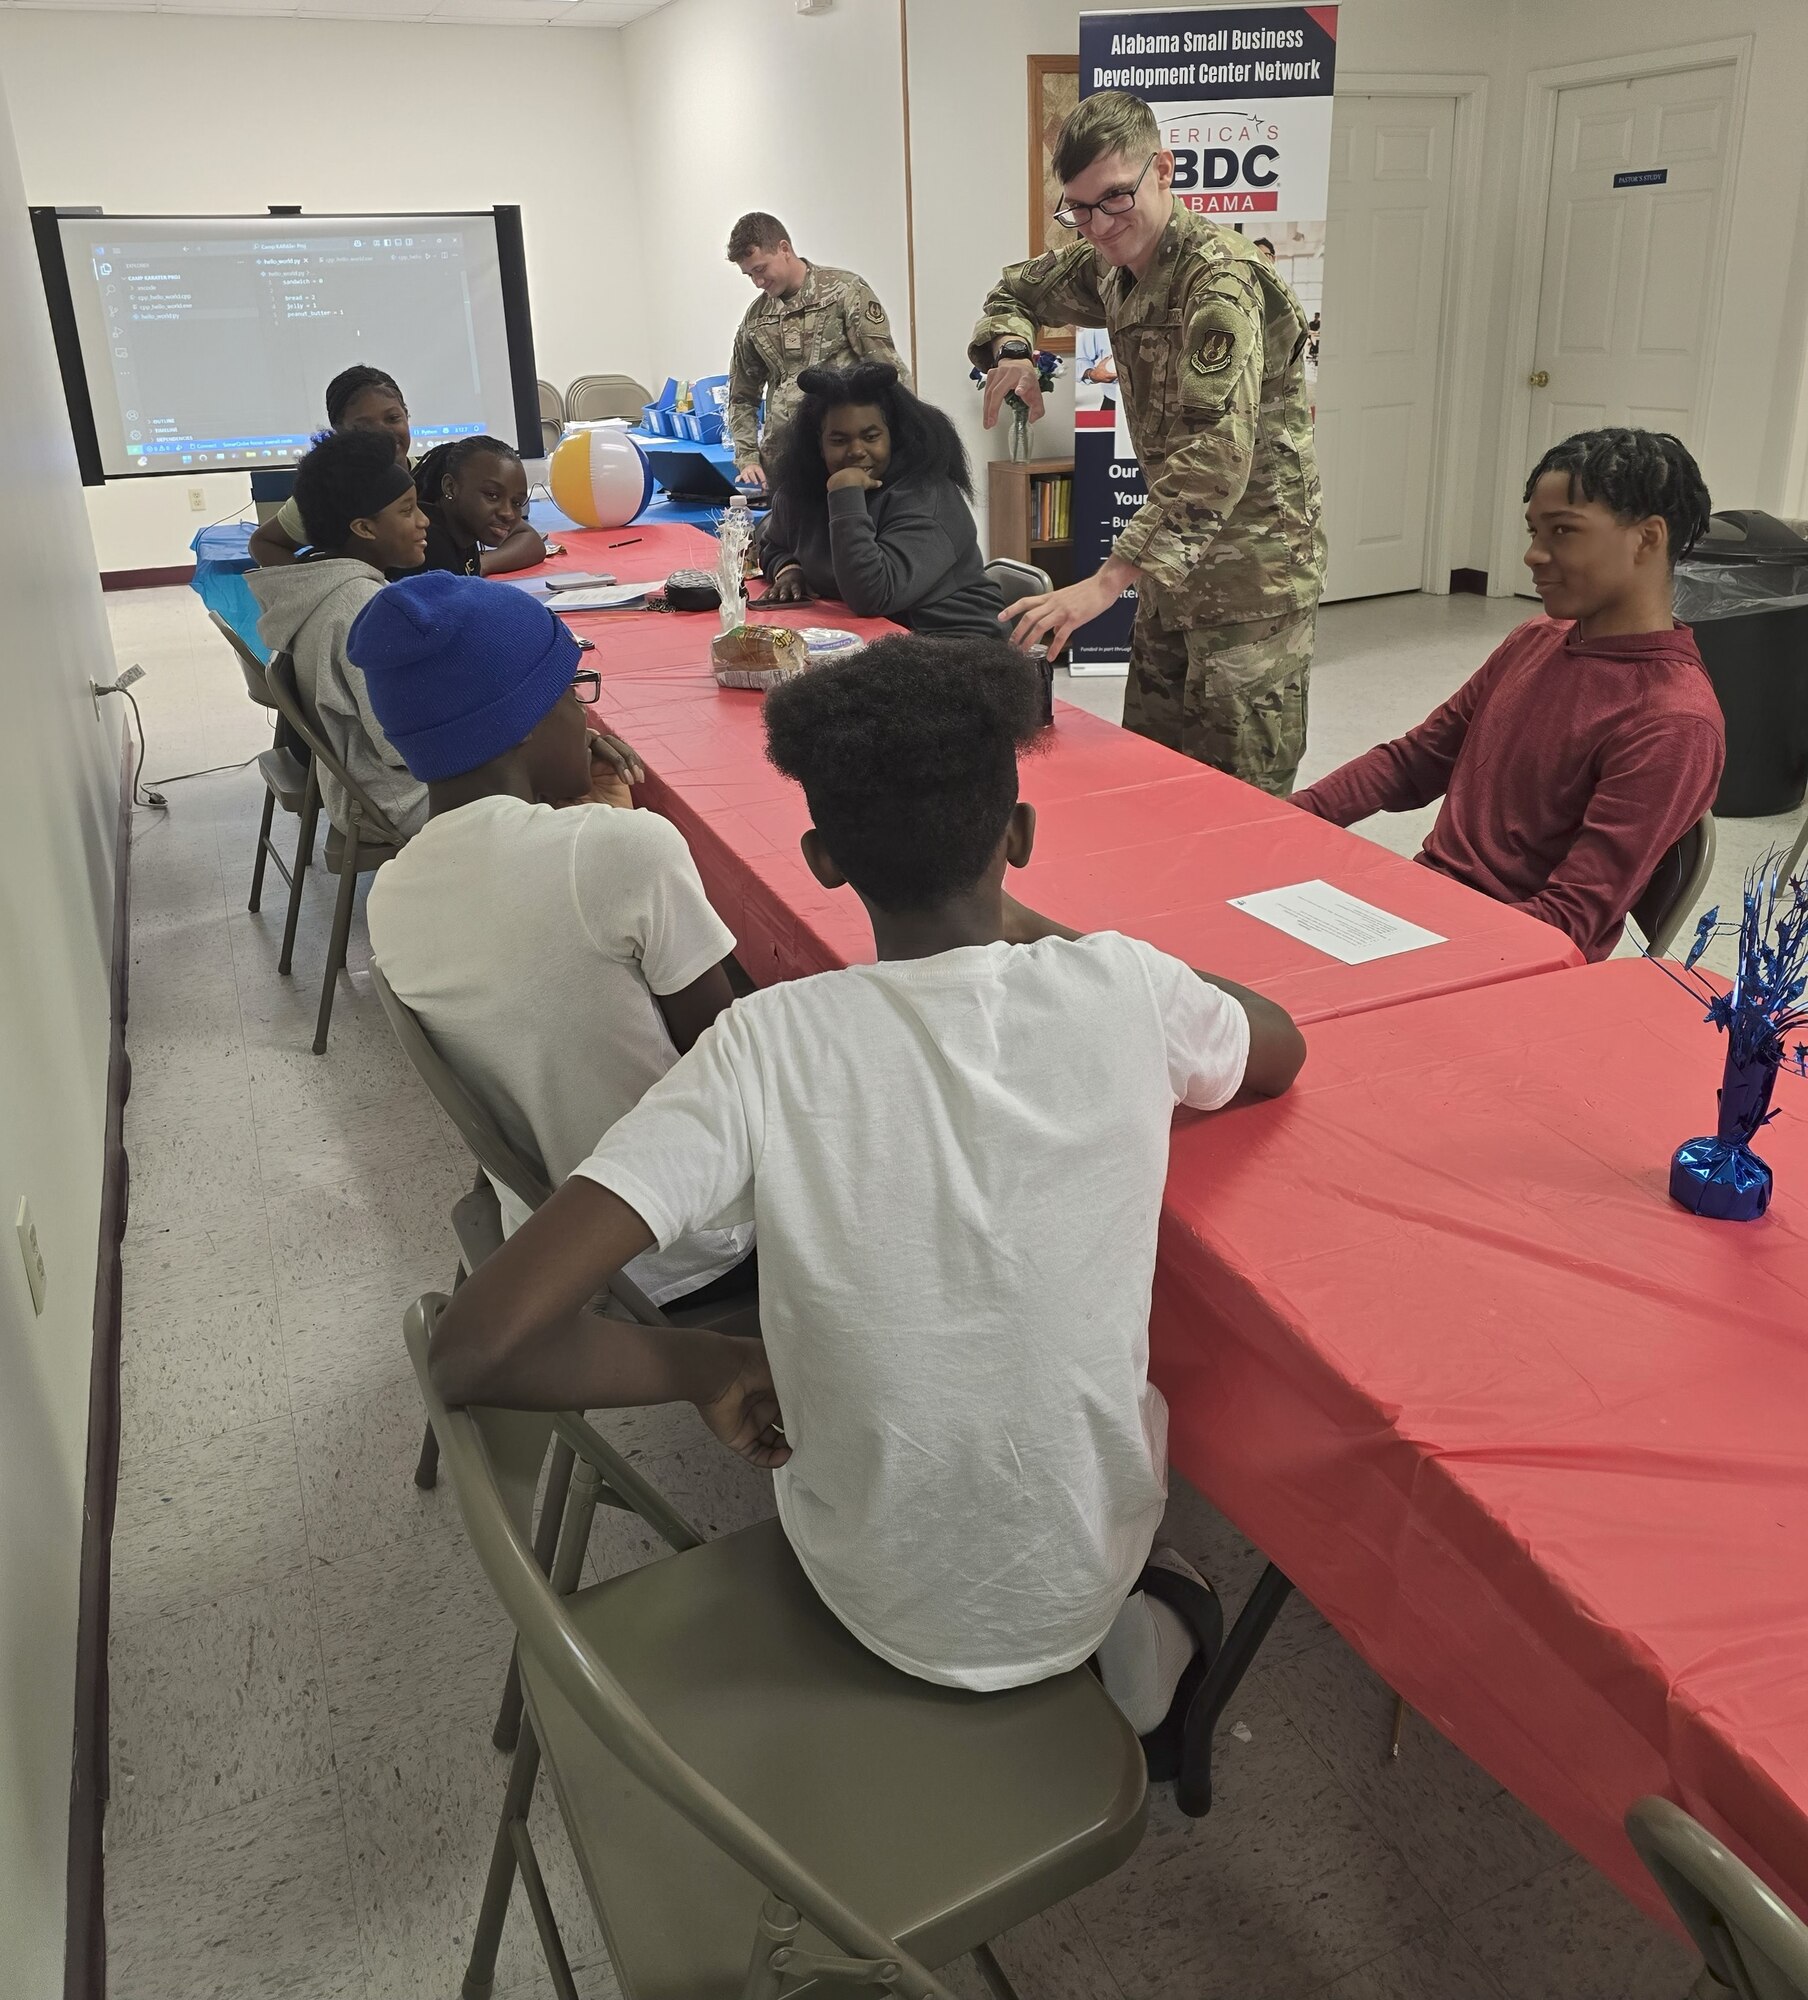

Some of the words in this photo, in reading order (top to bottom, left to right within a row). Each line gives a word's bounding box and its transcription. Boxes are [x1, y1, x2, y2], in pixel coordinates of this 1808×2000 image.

[1111, 34, 1179, 55] Alabama
[1184, 30, 1227, 52] Small
[1232, 28, 1303, 50] Business
[1094, 64, 1195, 88] Development
[1199, 62, 1251, 84] Center
[1255, 59, 1320, 81] Network
[1159, 125, 1278, 143] ERICA'S
[1170, 145, 1280, 188] BDC
[1180, 195, 1254, 212] BAMA
[287, 302, 304, 310] jelly
[287, 310, 331, 318] peanut_butter
[1109, 464, 1139, 479] Our
[1114, 491, 1148, 505] Your
